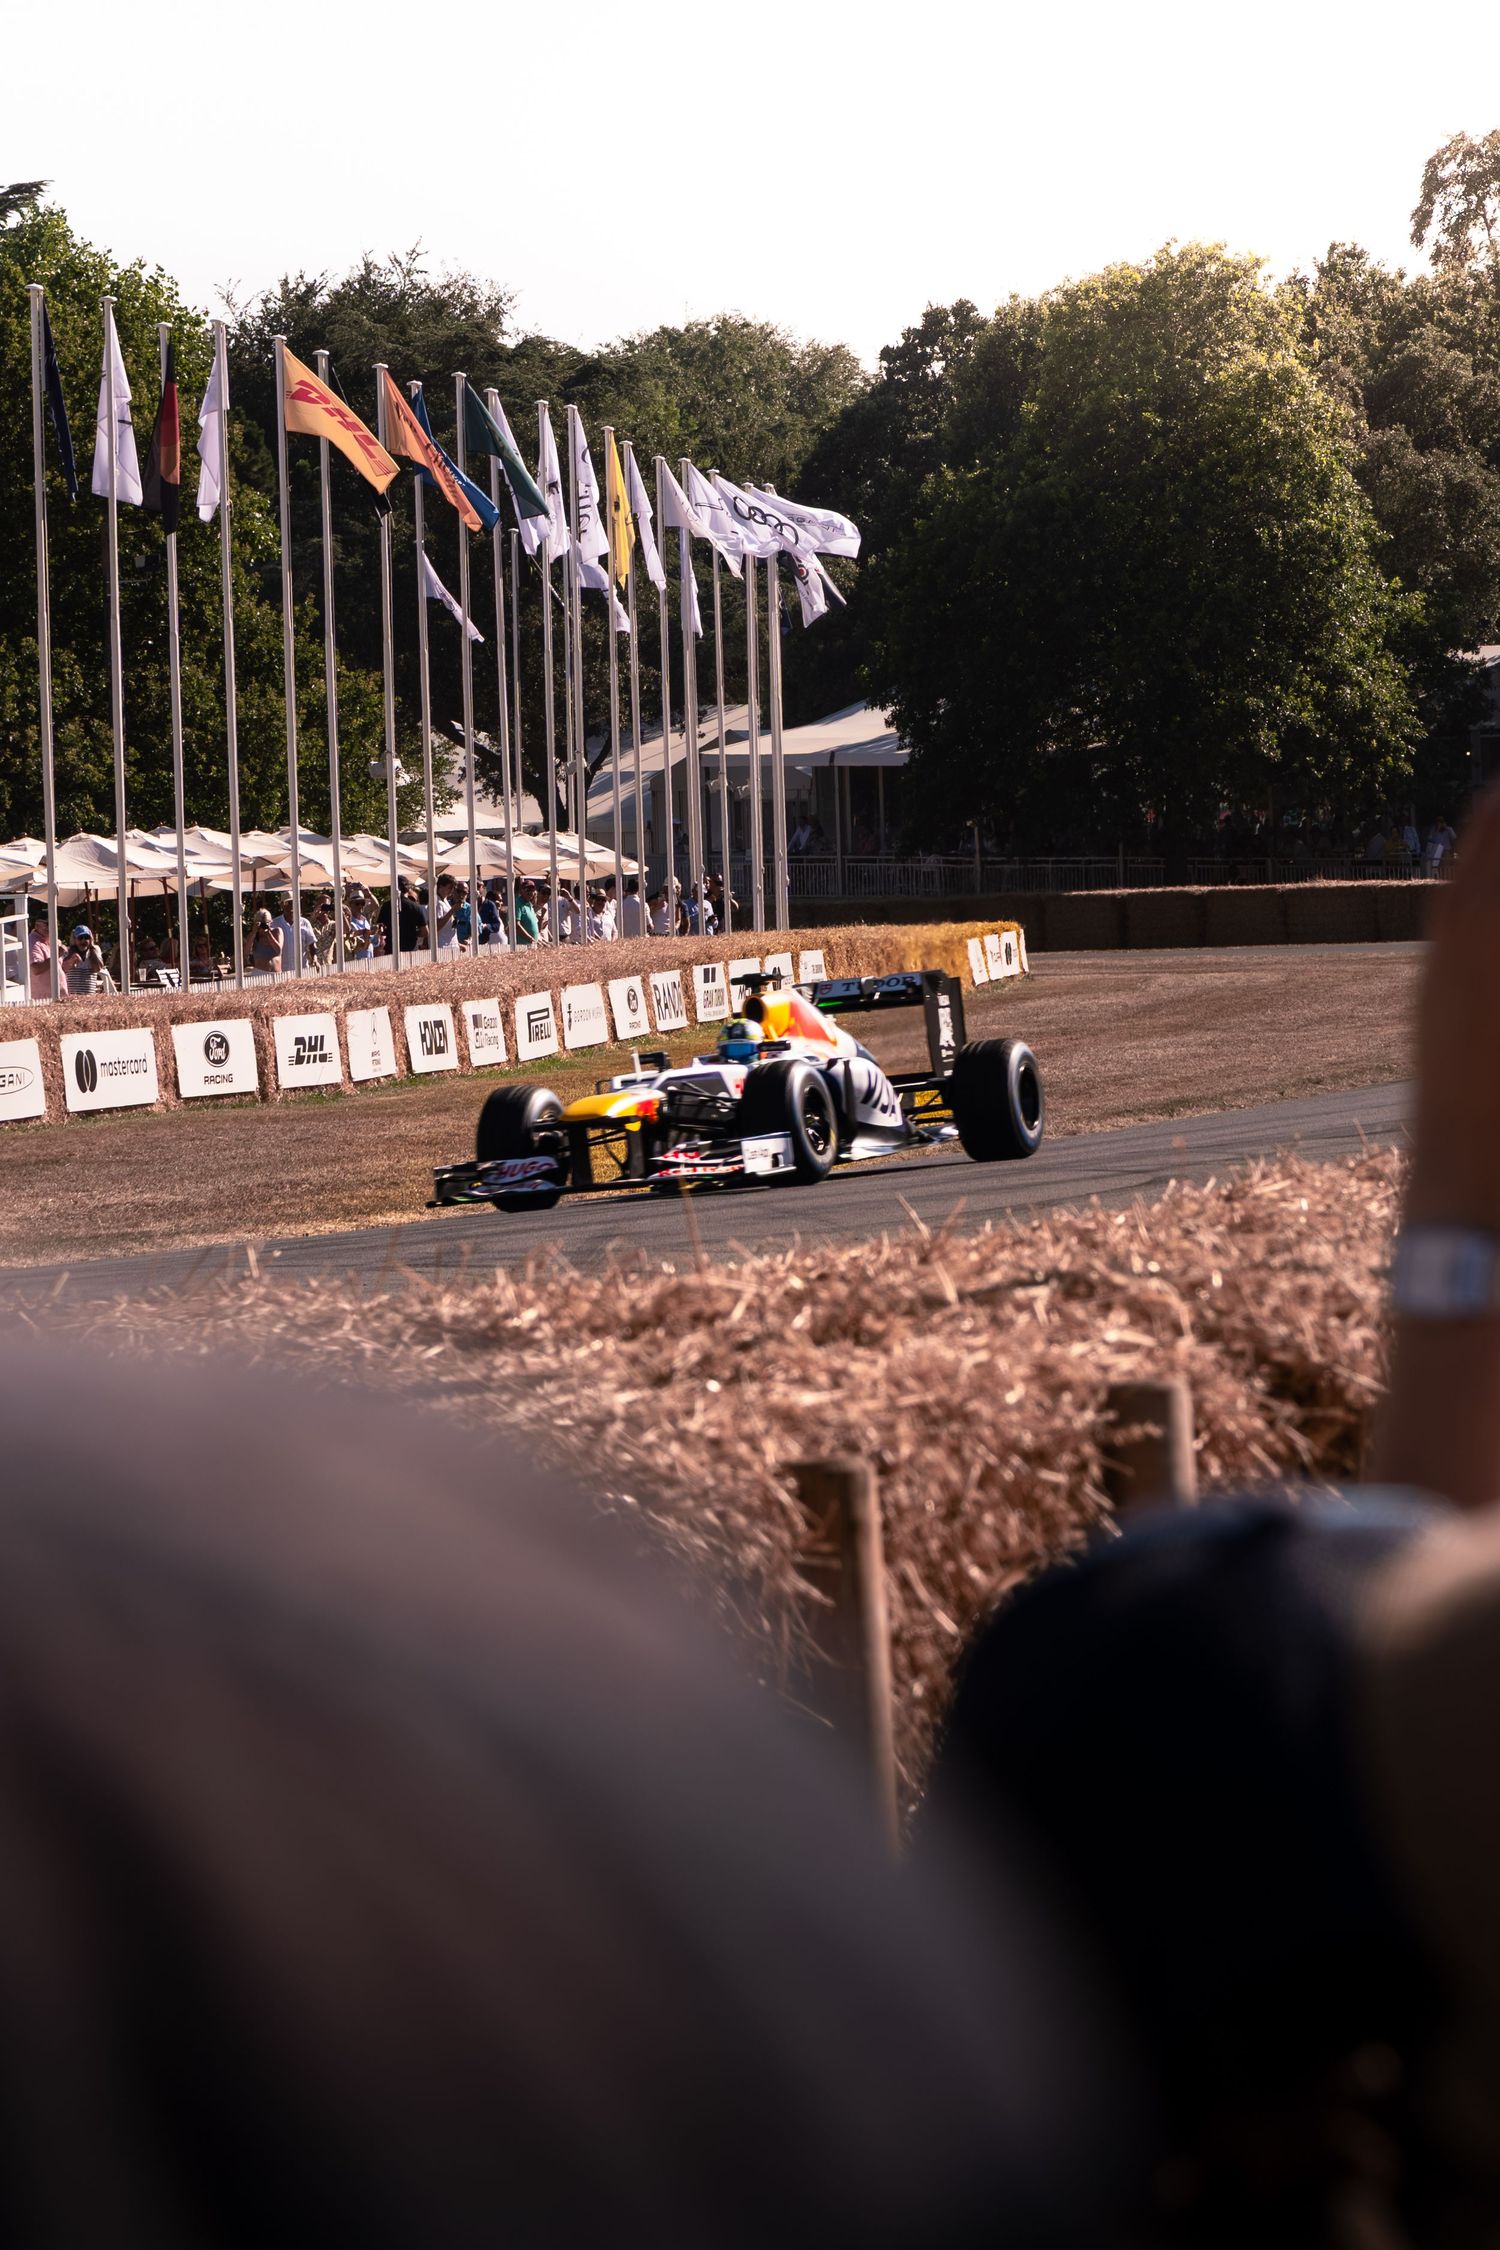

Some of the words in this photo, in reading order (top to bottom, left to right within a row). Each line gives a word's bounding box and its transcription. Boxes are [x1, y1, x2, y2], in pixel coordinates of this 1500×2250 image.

[289, 379, 379, 460] DHL
[418, 1020, 448, 1056] HOWDEN
[527, 1007, 552, 1043] PIRELLI
[208, 1036, 227, 1061] Ford
[294, 1035, 328, 1066] DHL
[100, 1053, 148, 1078] mastercard
[203, 1073, 234, 1085] RACING
[496, 1161, 555, 1179] HUGO
